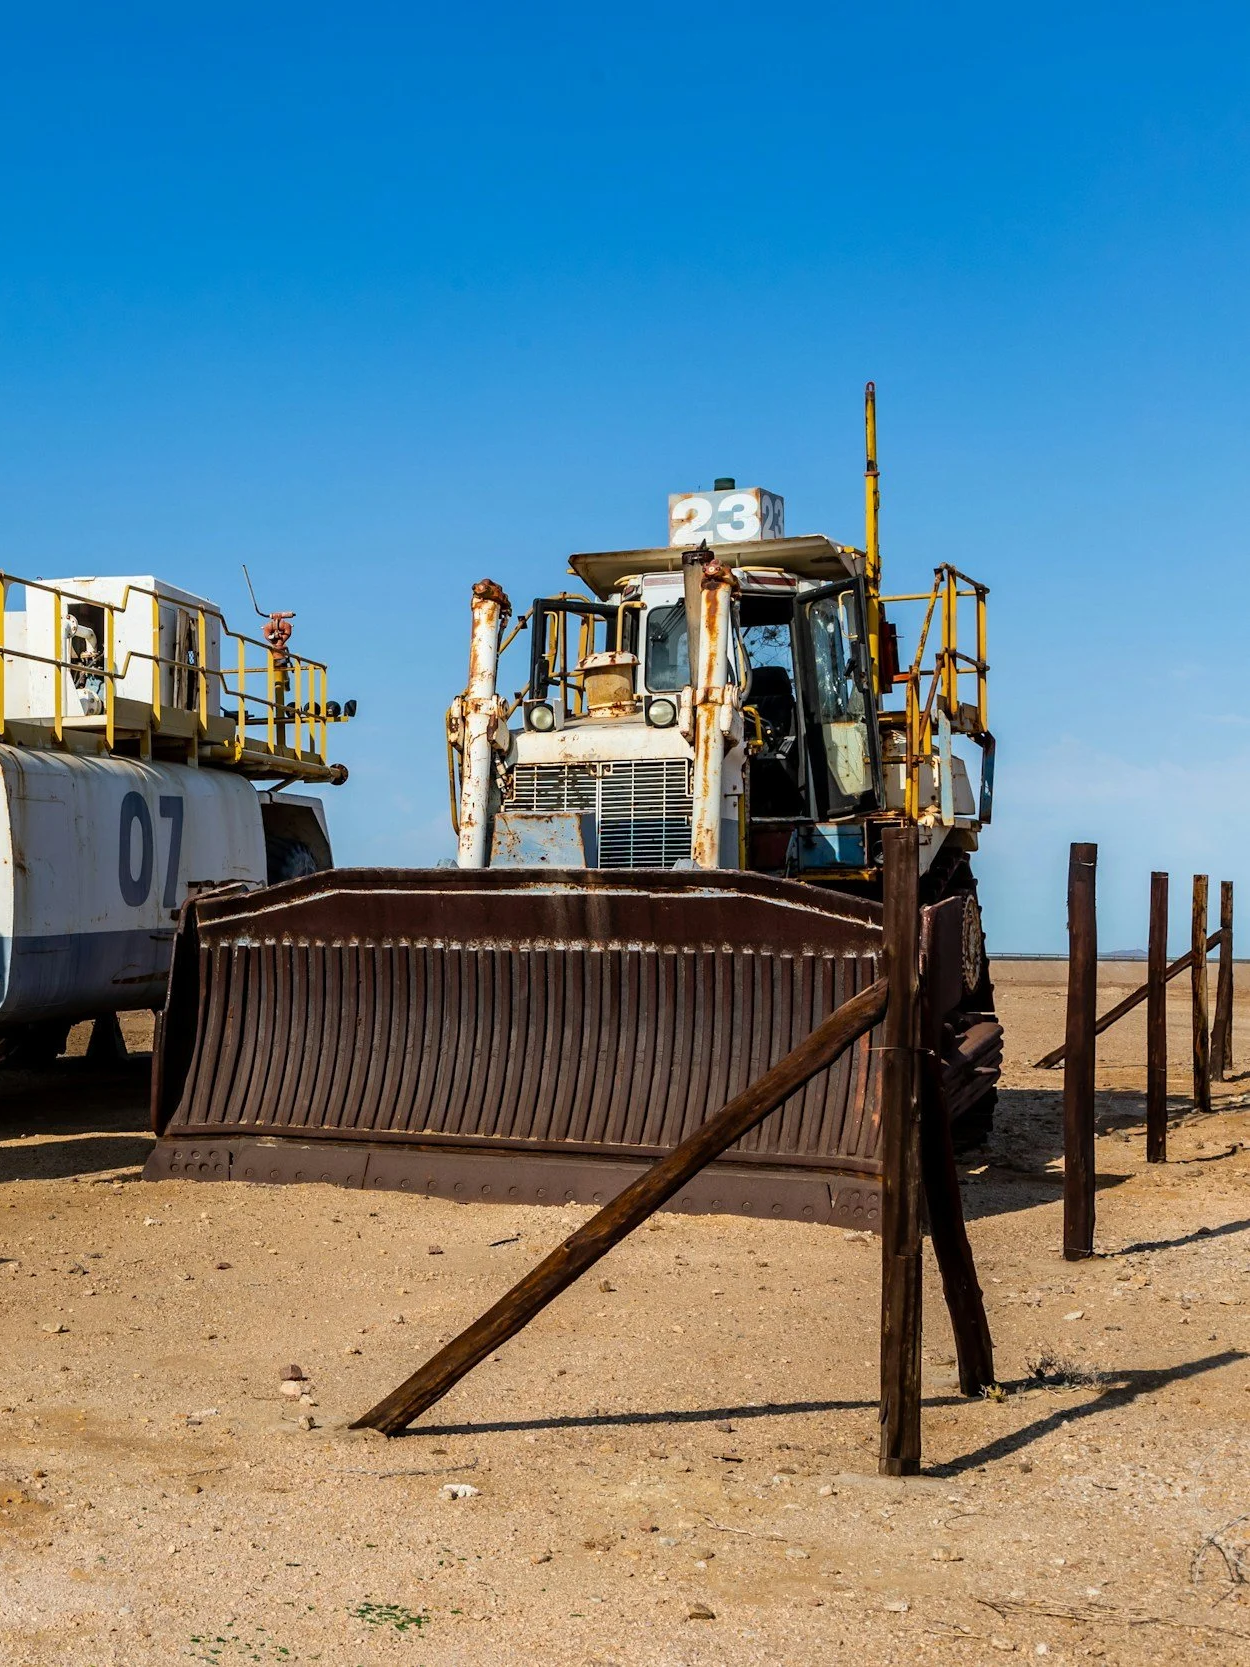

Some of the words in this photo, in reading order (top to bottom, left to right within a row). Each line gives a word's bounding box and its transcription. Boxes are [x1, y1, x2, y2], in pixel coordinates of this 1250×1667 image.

[671, 493, 761, 546] 23
[762, 494, 784, 540] 23
[118, 790, 184, 909] 07
